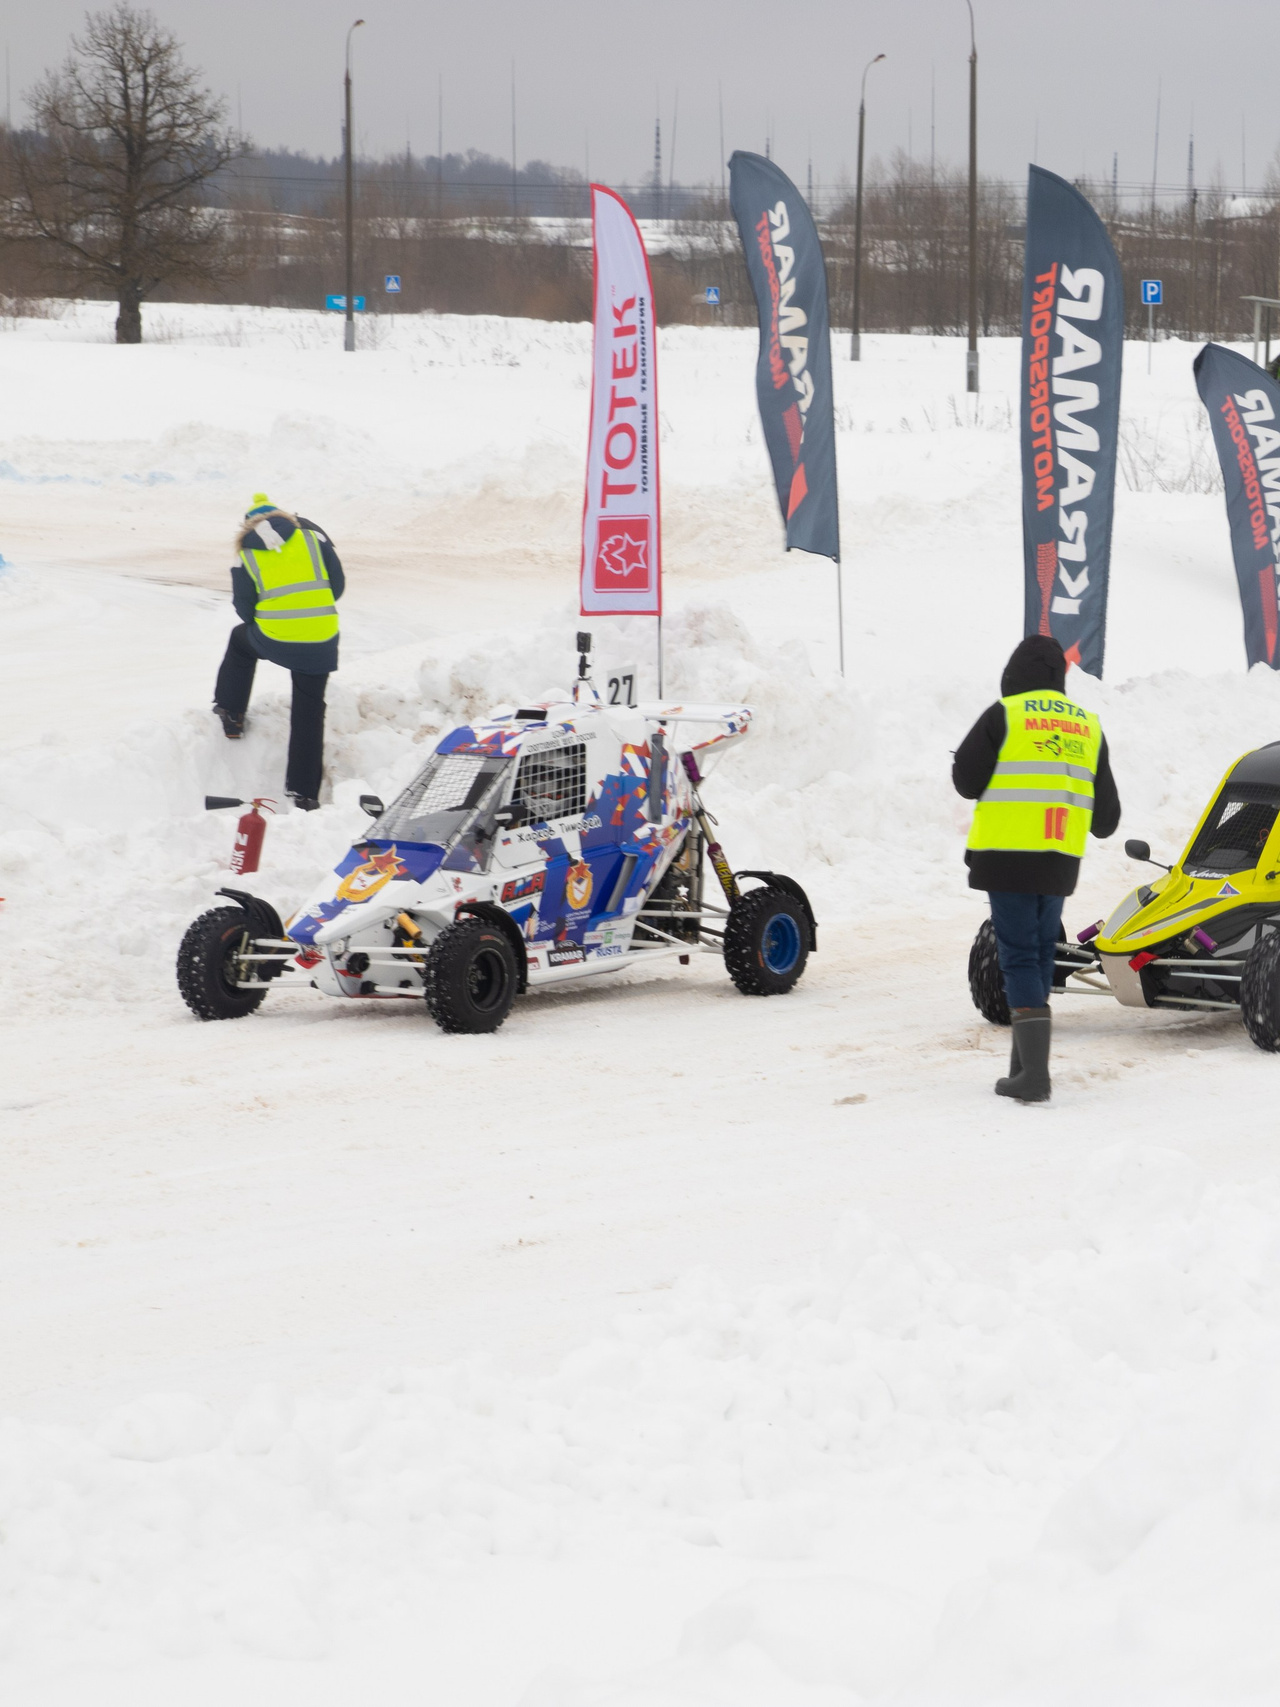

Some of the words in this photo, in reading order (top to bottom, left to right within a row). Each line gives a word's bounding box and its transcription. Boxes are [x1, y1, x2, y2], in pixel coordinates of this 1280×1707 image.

[1146, 282, 1160, 302] P
[608, 674, 635, 706] 27
[1024, 699, 1088, 720] RUSTA
[1024, 717, 1091, 739] МАРШАЛ
[549, 949, 584, 963] KRAMAR
[595, 944, 623, 958] RUSTA
